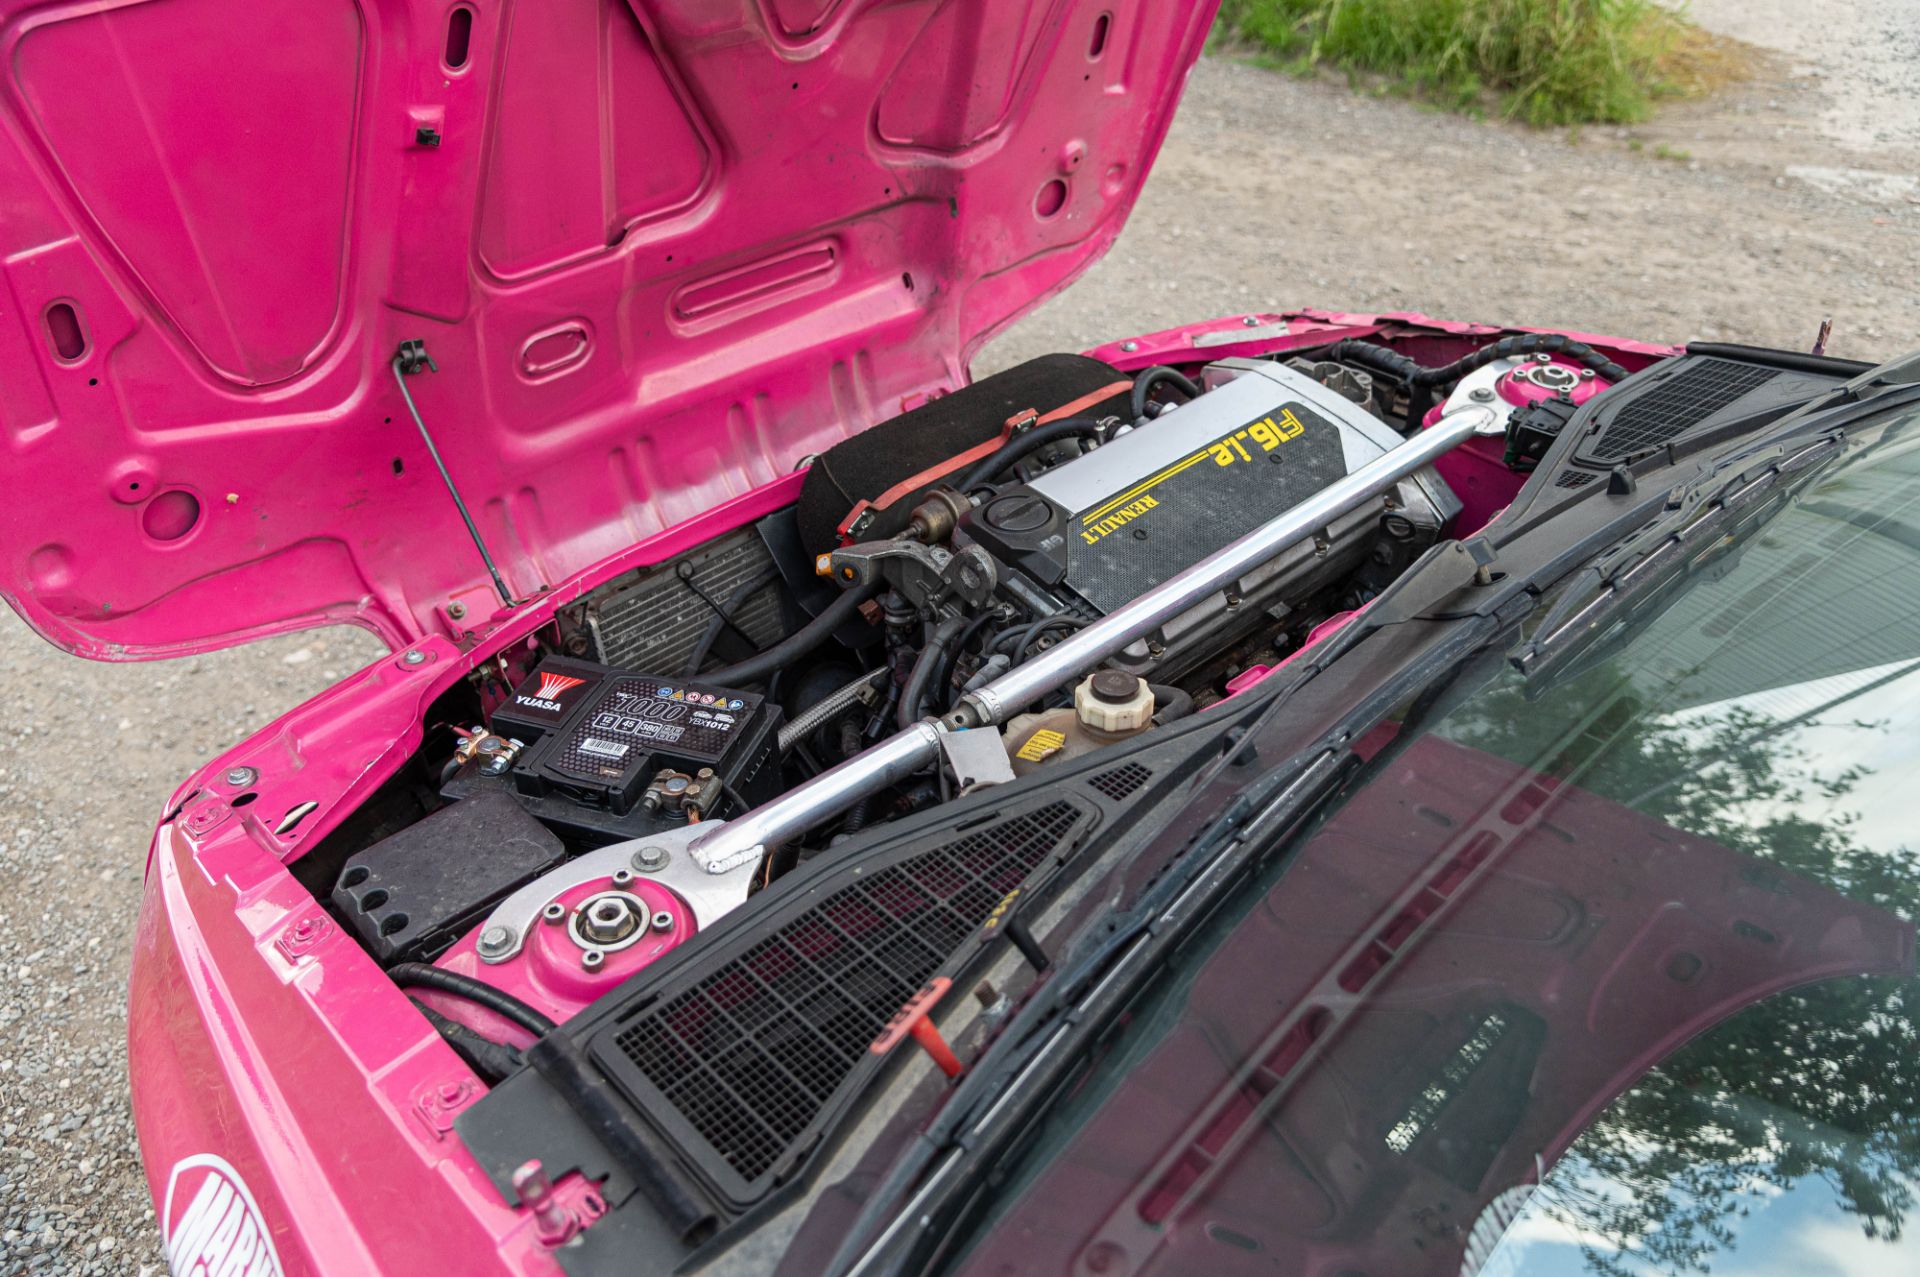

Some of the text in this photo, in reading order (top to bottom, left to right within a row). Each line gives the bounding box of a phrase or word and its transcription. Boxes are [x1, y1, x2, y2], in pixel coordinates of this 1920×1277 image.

[1080, 494, 1160, 545] RENAULT
[516, 695, 561, 712] YUASA
[615, 696, 688, 721] 1000
[602, 716, 614, 724] 12
[622, 720, 635, 728] 45
[689, 717, 730, 731] YBX1012
[641, 723, 658, 732] 380
